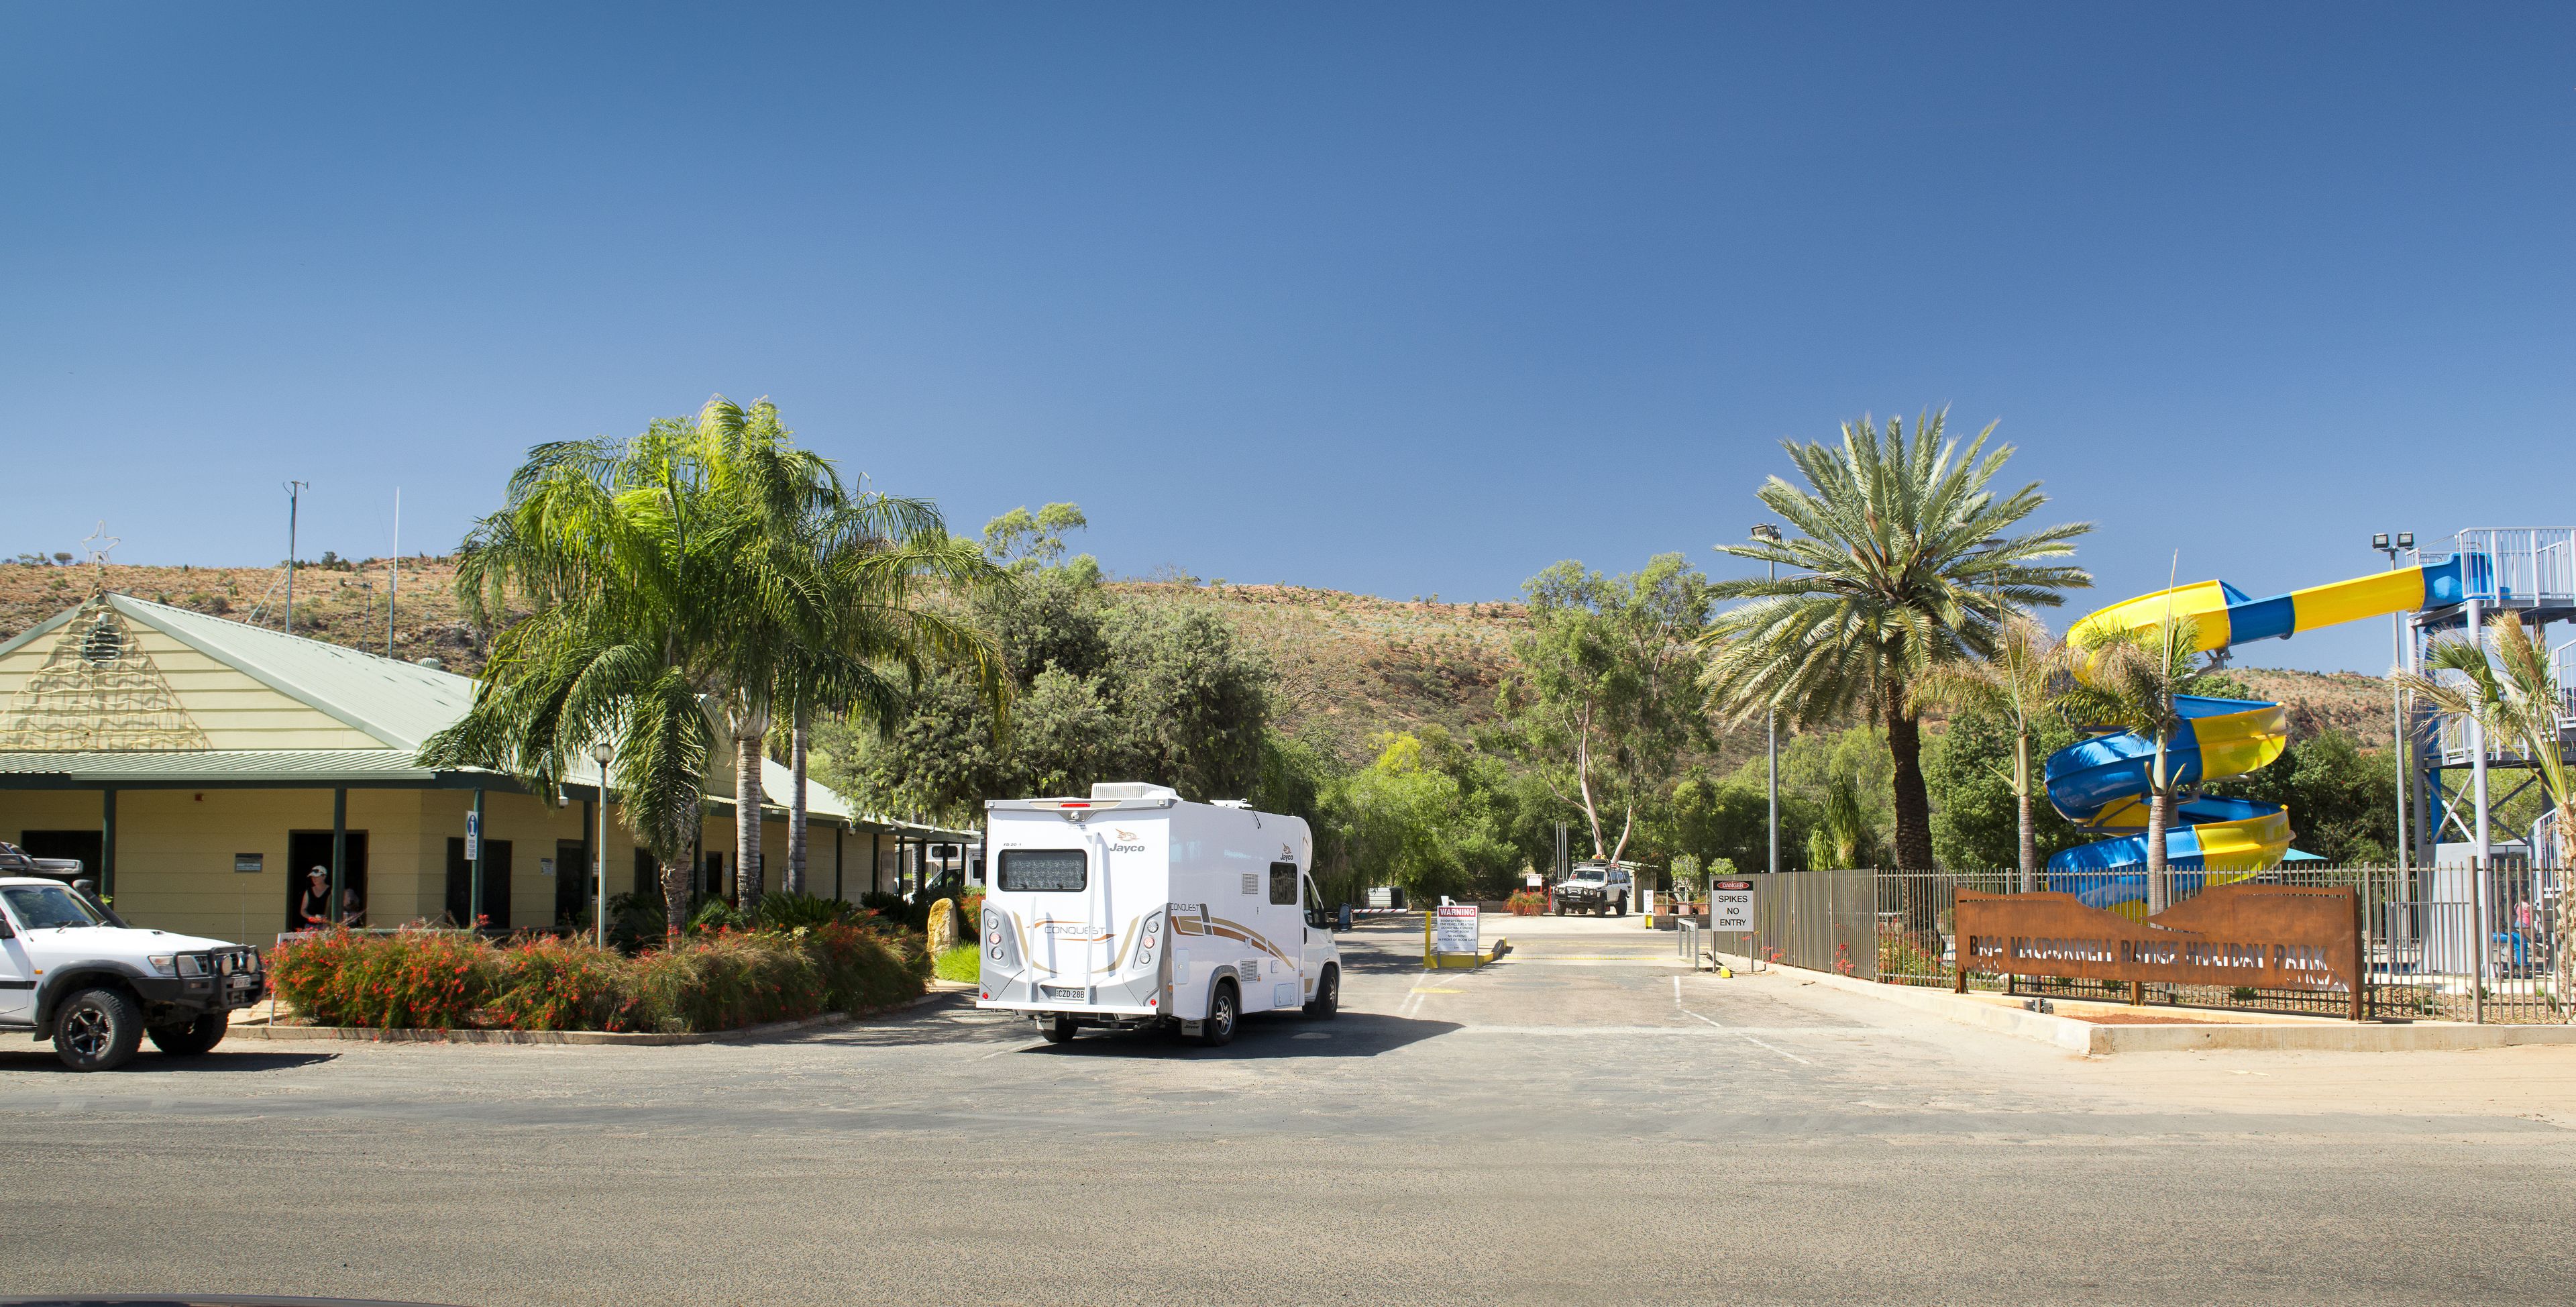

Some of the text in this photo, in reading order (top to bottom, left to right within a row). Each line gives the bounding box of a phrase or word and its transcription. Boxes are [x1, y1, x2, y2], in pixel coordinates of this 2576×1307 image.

[1109, 843, 1146, 853] Jayco
[1280, 853, 1294, 862] Jayco
[1718, 895, 1748, 903] SPIKES
[1171, 902, 1199, 912] CONQUEST
[1727, 907, 1739, 915] NO
[1440, 908, 1475, 916] WARNING
[1044, 926, 1106, 935] CONQUEST
[1970, 935, 2328, 971] BIG4 MACDONNELL RANGE HOLIDAY PARK
